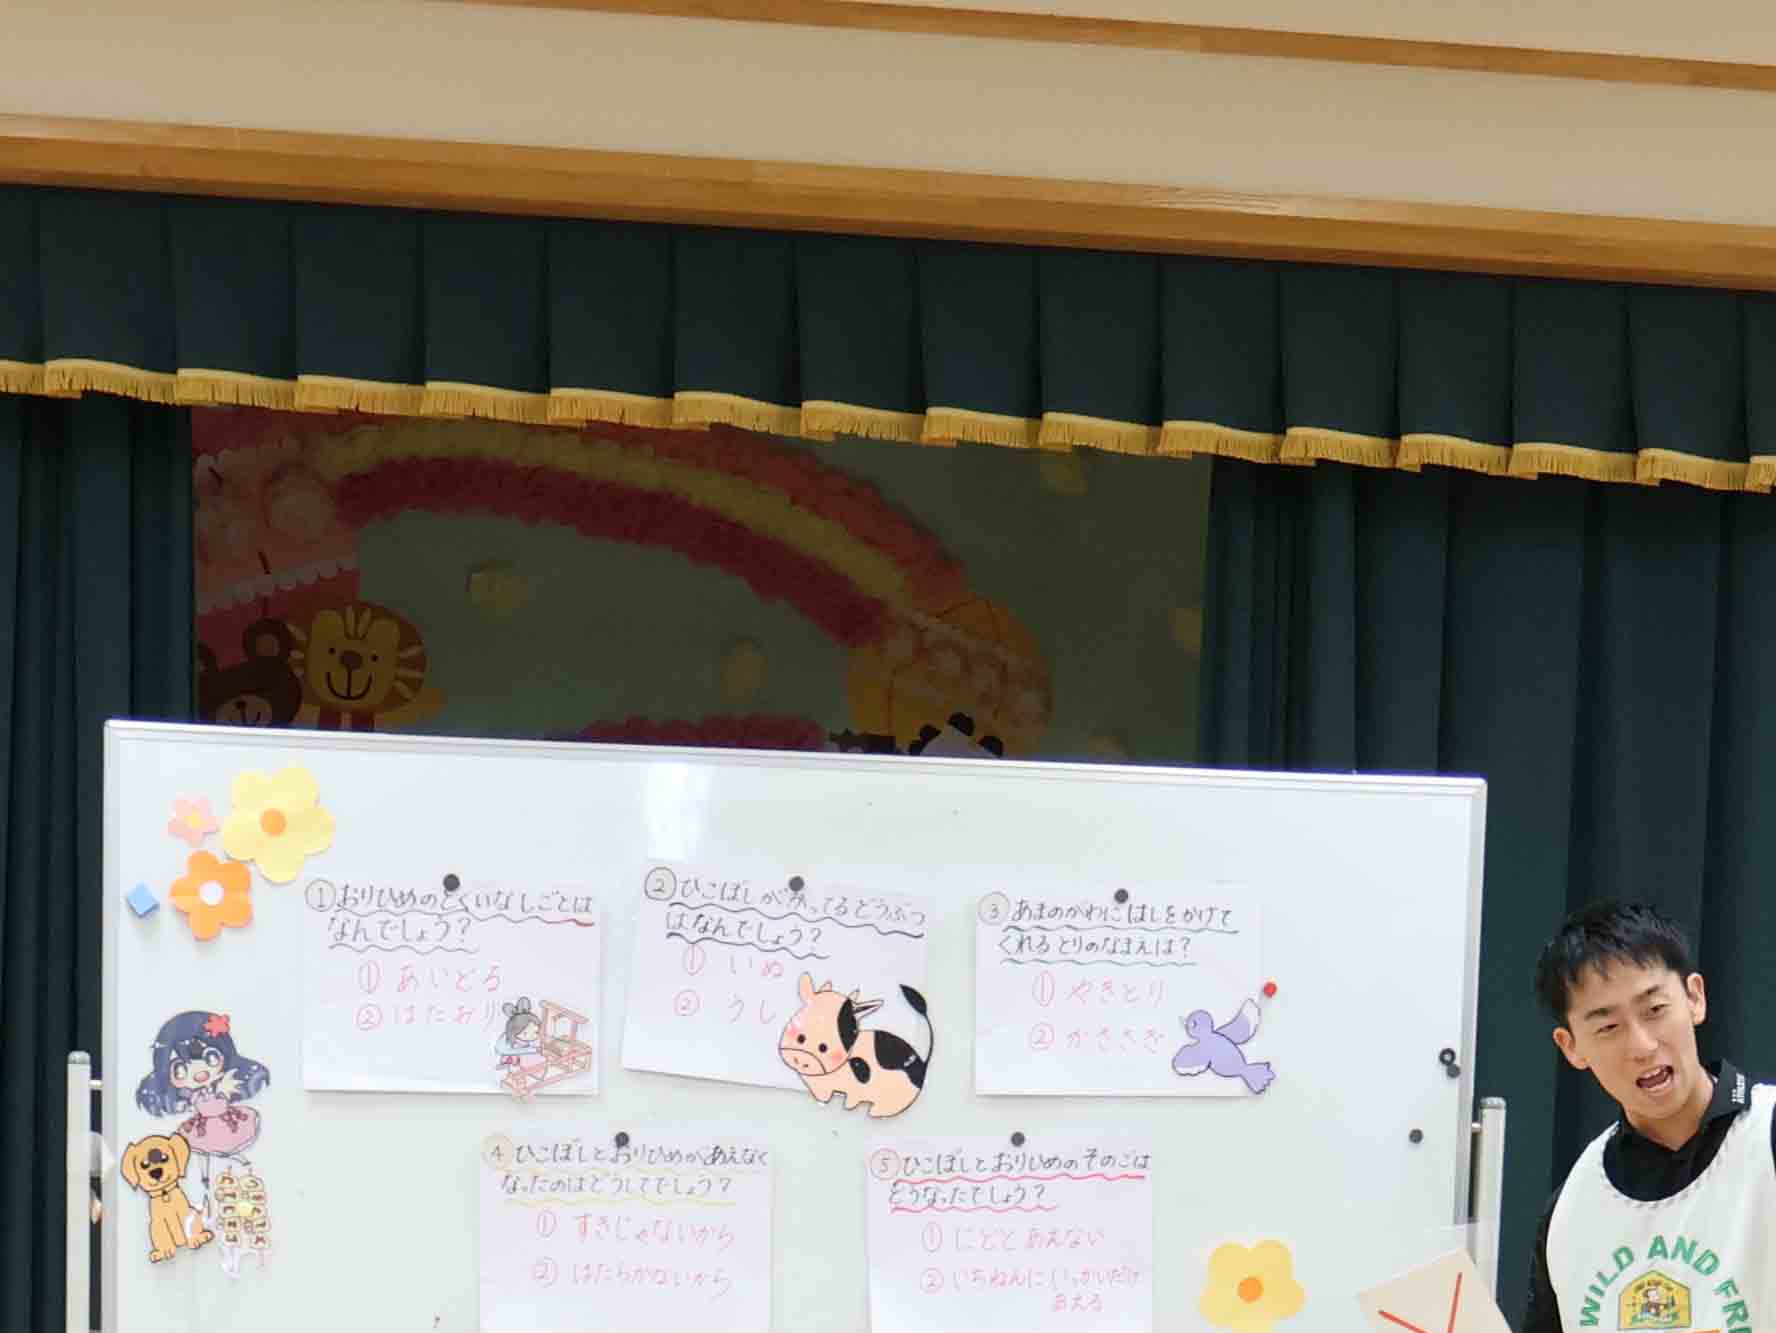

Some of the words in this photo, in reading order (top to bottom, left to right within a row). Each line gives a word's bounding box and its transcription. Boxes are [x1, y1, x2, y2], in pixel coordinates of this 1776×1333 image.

[728, 994, 776, 1025] うし
[1579, 1246, 1634, 1327] WILD
[1647, 1235, 1721, 1276] AND
